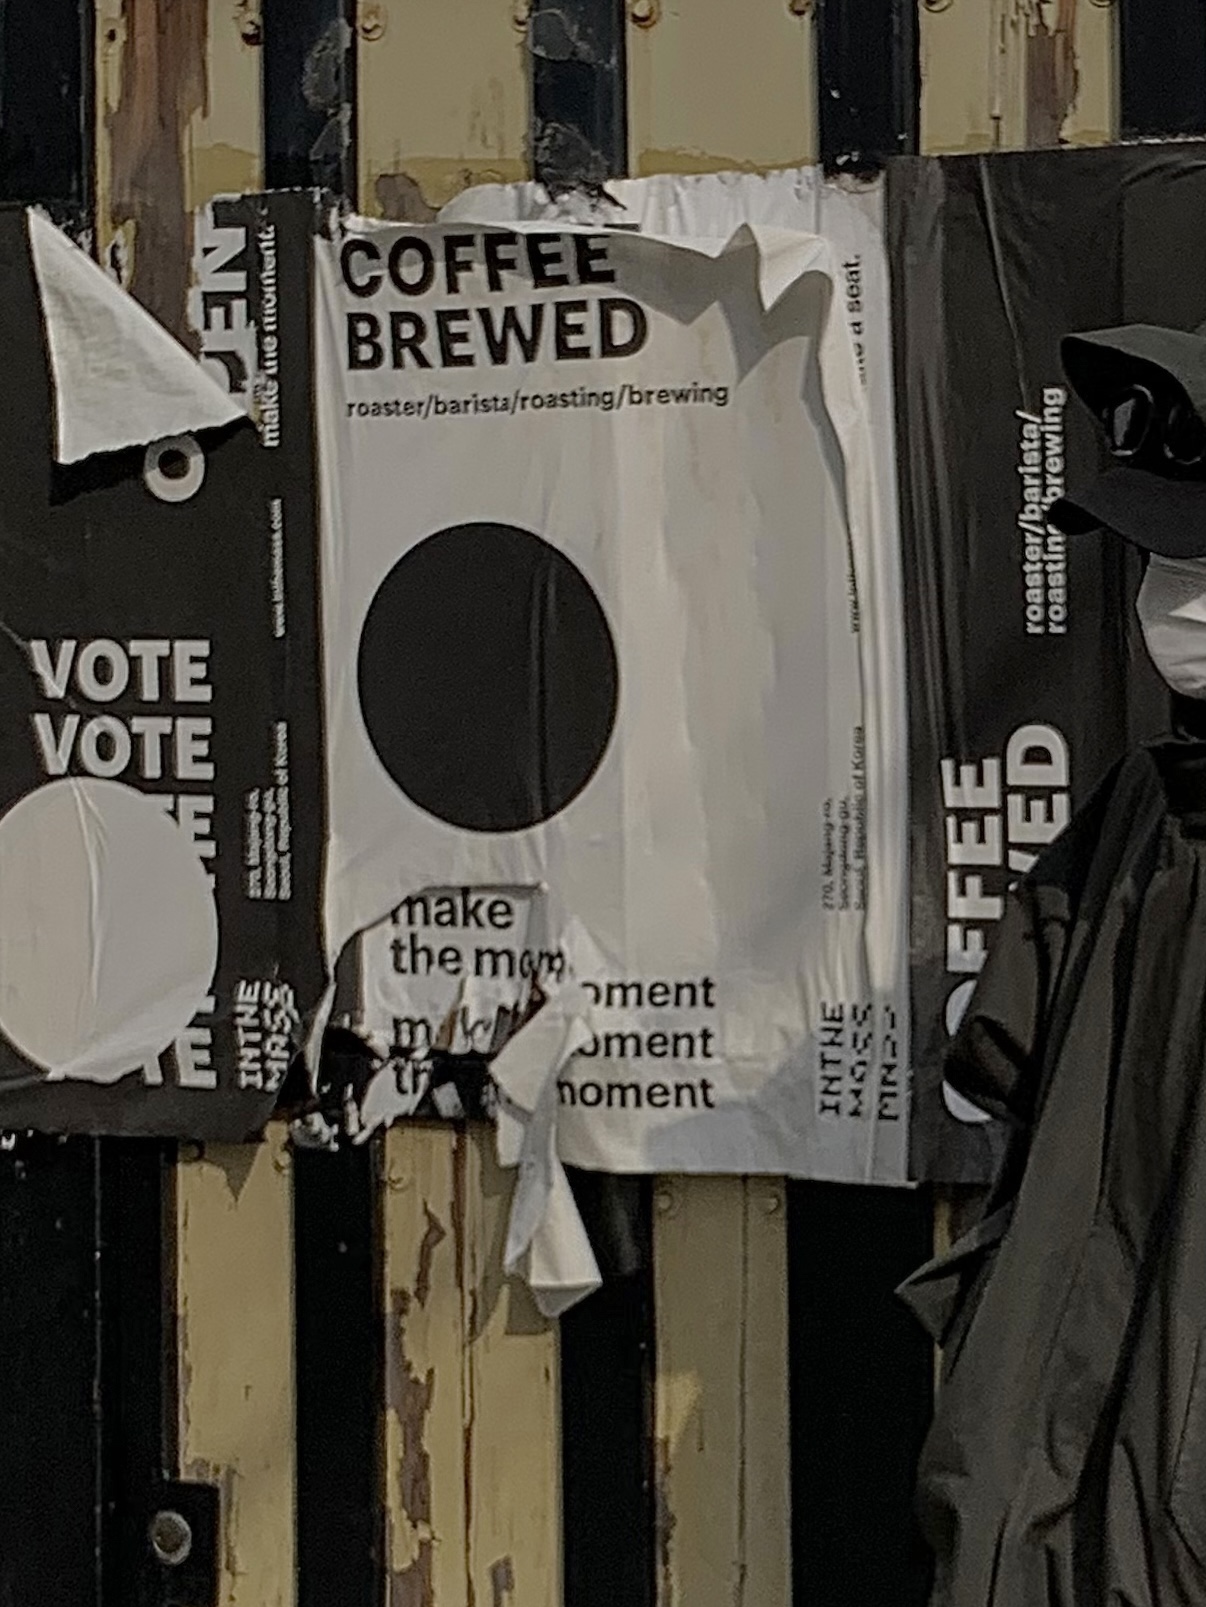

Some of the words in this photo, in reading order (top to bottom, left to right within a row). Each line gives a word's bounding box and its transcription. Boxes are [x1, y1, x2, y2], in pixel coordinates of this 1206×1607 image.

[340, 232, 616, 298] COFFEE
[346, 298, 648, 370] BREWED
[346, 382, 729, 418] roaster/barista/roasting/brewing
[1015, 409, 1045, 634] roaster/barista/
[31, 640, 212, 702] VOTE
[34, 713, 214, 780] VOTE
[391, 887, 513, 929] make
[391, 933, 463, 974] the
